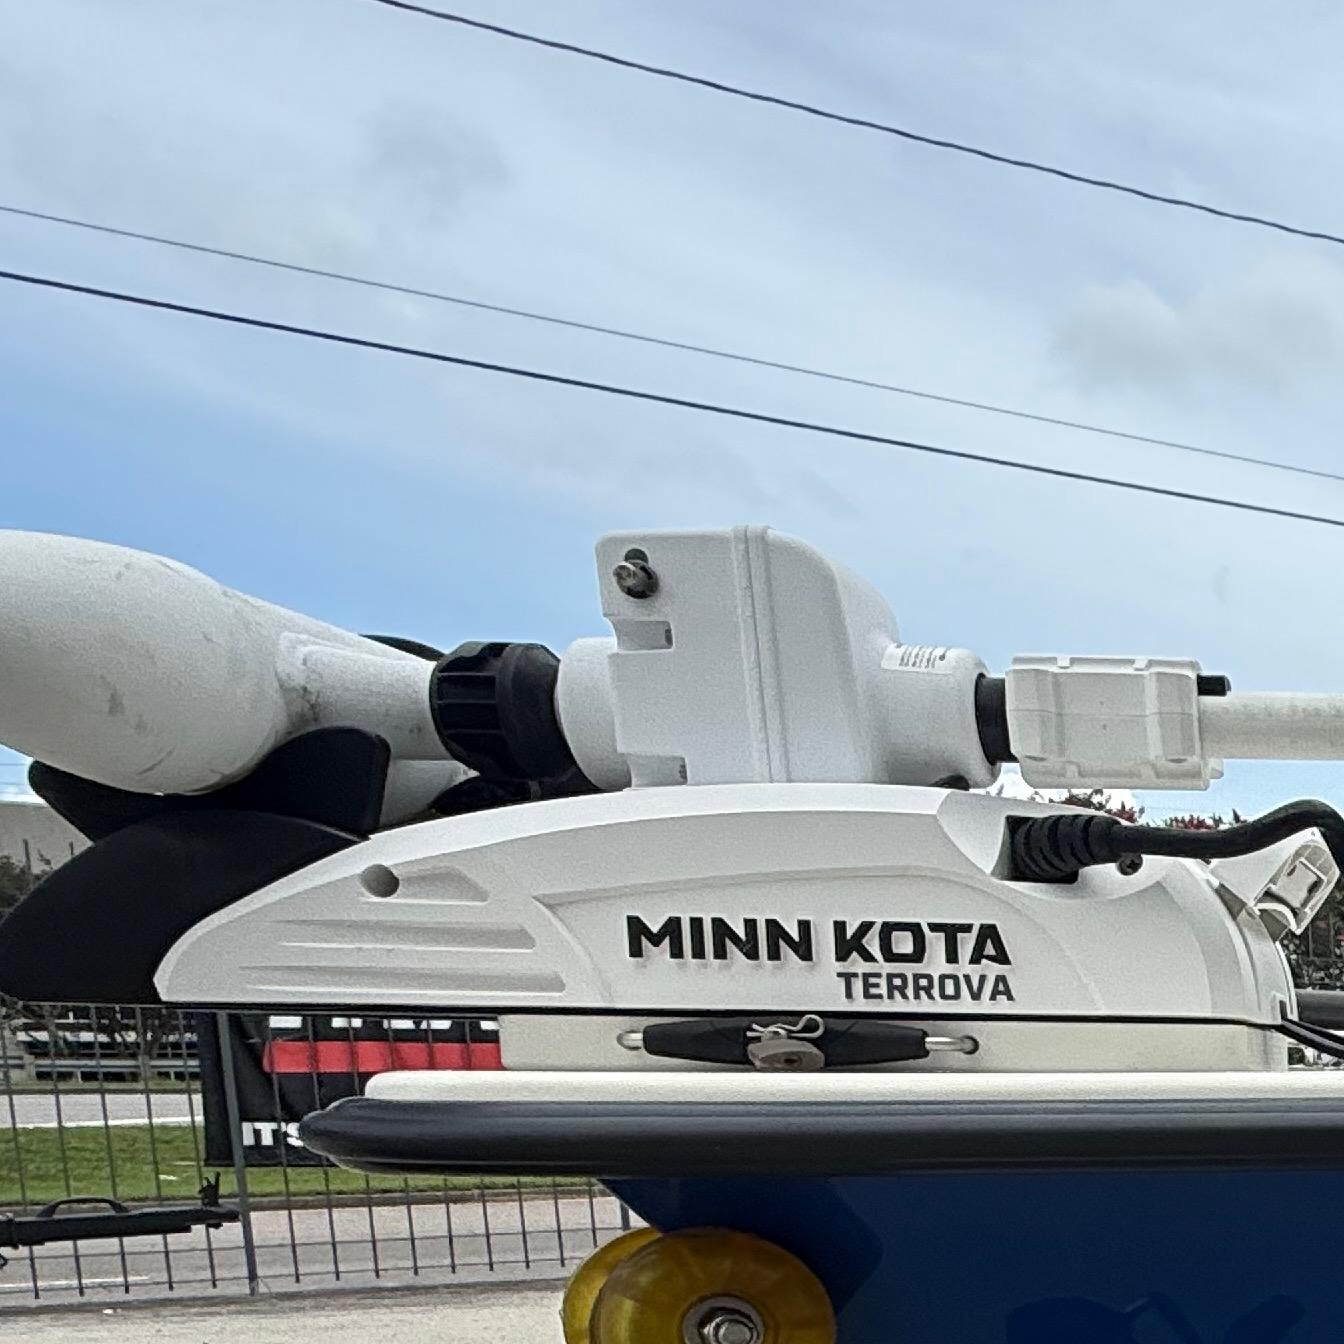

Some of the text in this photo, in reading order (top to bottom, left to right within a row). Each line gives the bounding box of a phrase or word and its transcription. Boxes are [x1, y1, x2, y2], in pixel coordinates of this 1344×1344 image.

[627, 914, 1013, 966] MINN KOTA
[836, 971, 1017, 1002] TERROVA
[242, 1121, 304, 1147] IT'S
